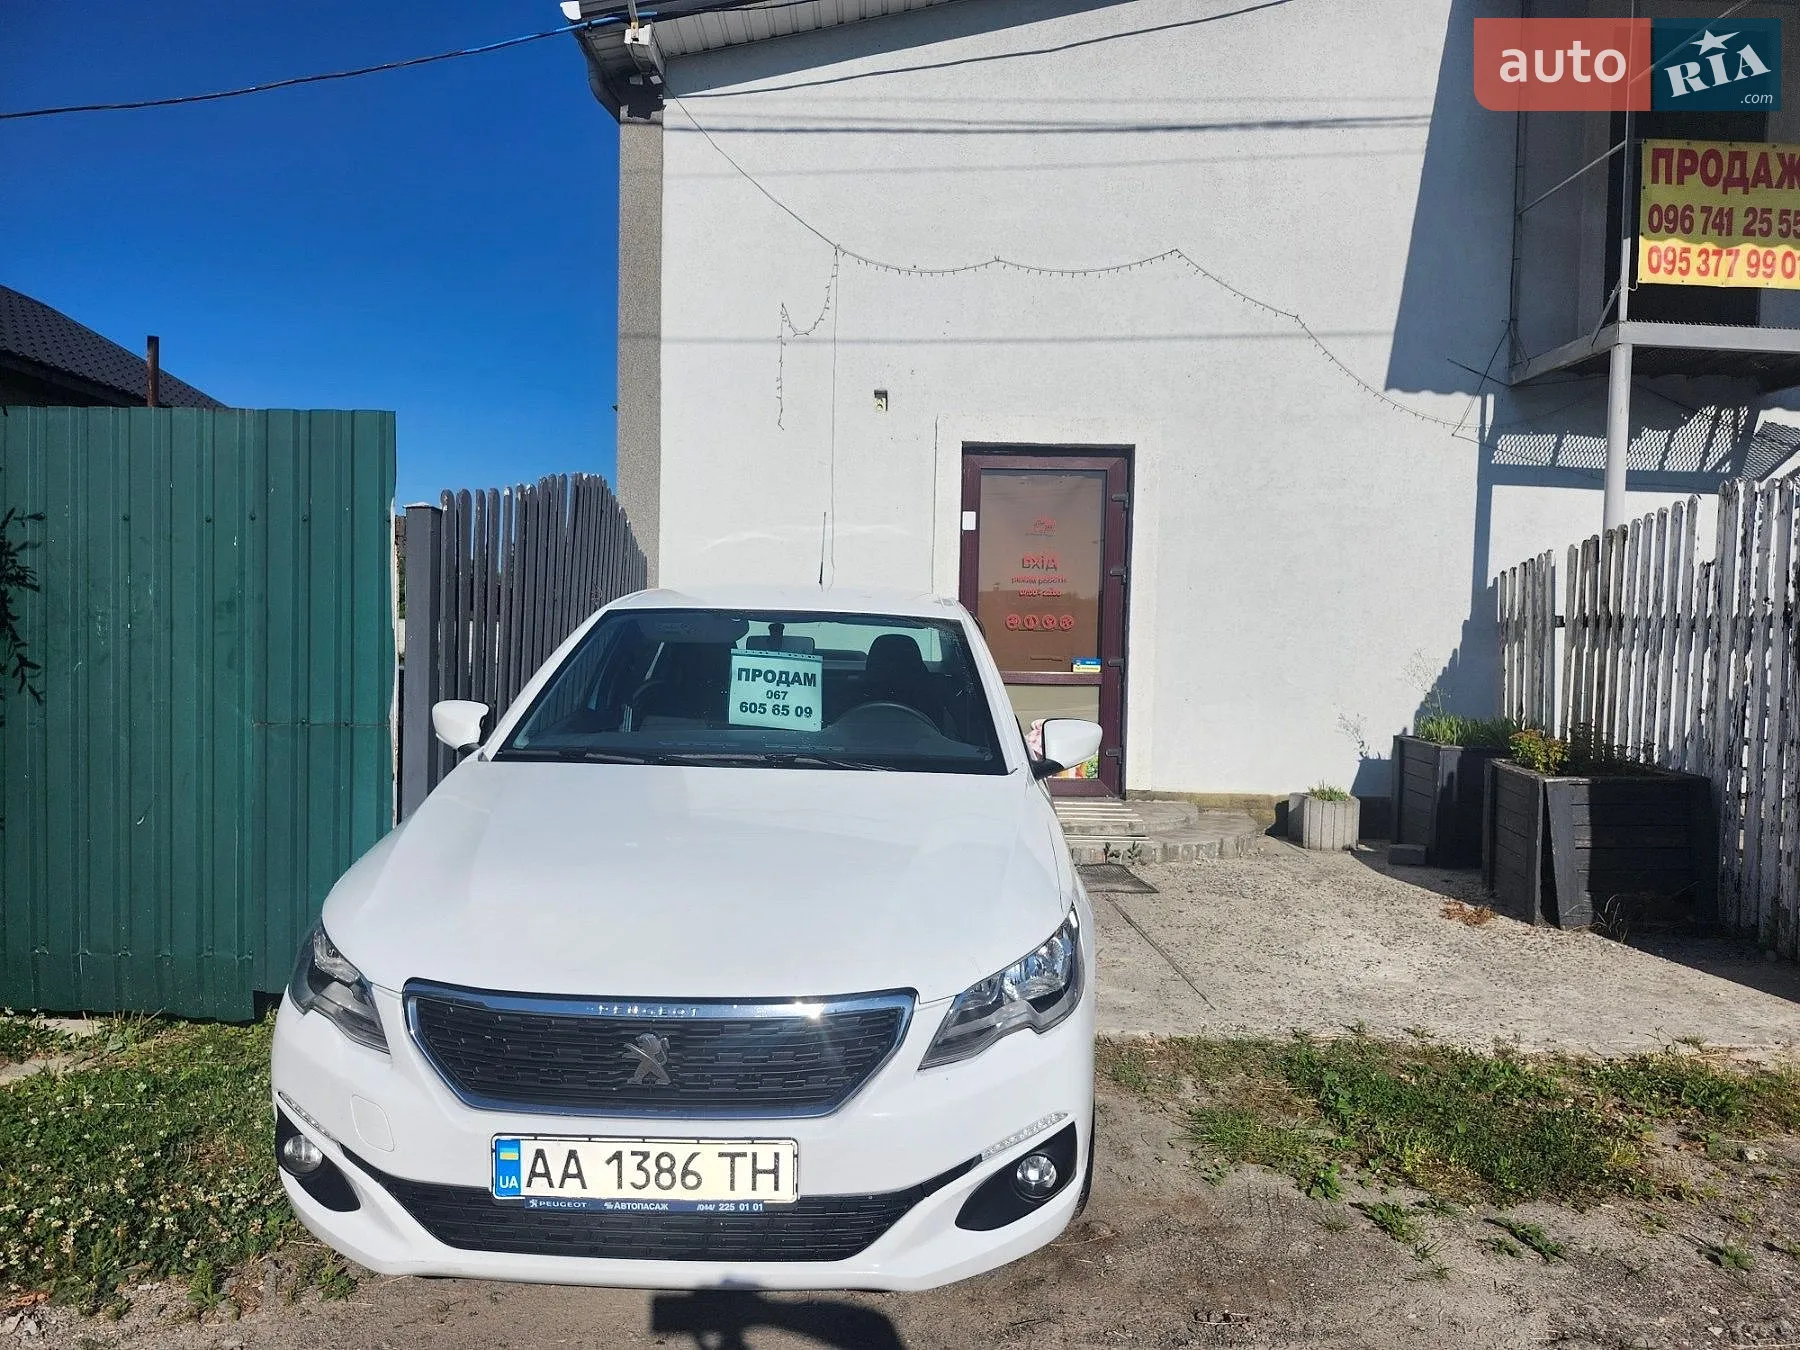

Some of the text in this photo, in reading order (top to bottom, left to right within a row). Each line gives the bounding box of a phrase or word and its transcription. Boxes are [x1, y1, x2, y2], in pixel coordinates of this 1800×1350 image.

[1647, 203, 1695, 236] 096
[1700, 206, 1734, 237] 741
[1742, 206, 1773, 238] 25
[1647, 245, 1800, 280] 095 377 99 0
[737, 667, 817, 687] ПРОДАМ
[765, 690, 788, 701] 067
[739, 701, 813, 718] 605 65 09
[525, 1148, 780, 1192] AA 1386 TH
[499, 1177, 519, 1189] UA
[614, 1202, 669, 1211] АВТОПАСАЖ
[718, 1203, 736, 1211] 225
[738, 1203, 750, 1212] 01
[752, 1203, 764, 1212] 01
